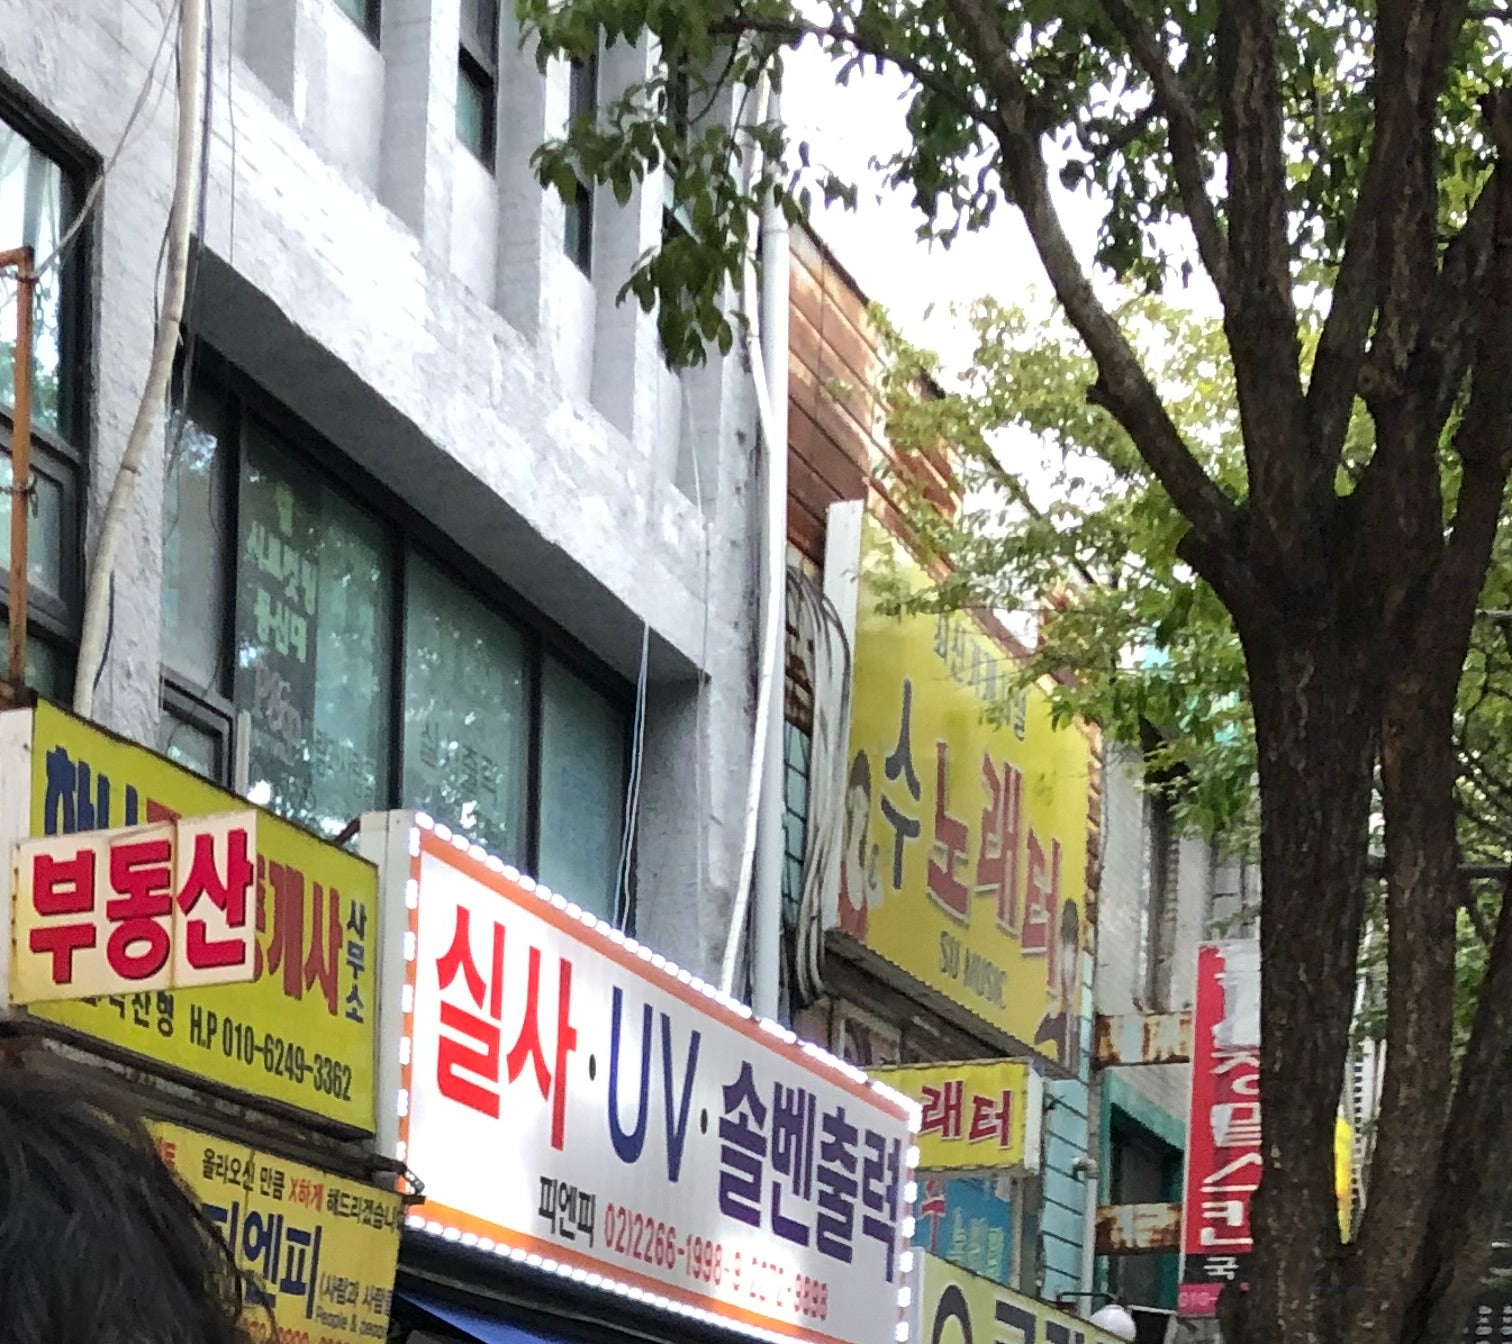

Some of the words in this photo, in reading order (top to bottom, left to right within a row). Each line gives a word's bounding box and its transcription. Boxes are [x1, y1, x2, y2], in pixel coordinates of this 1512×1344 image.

[29, 827, 255, 986] 부동산
[255, 851, 344, 1018] 개사
[344, 898, 369, 1025] 사무소
[221, 1016, 354, 1103] 010-6249-3362
[920, 1080, 1013, 1149] 래터
[326, 1186, 400, 1234] 해드리겠습니
[538, 1175, 597, 1249] 피엔피
